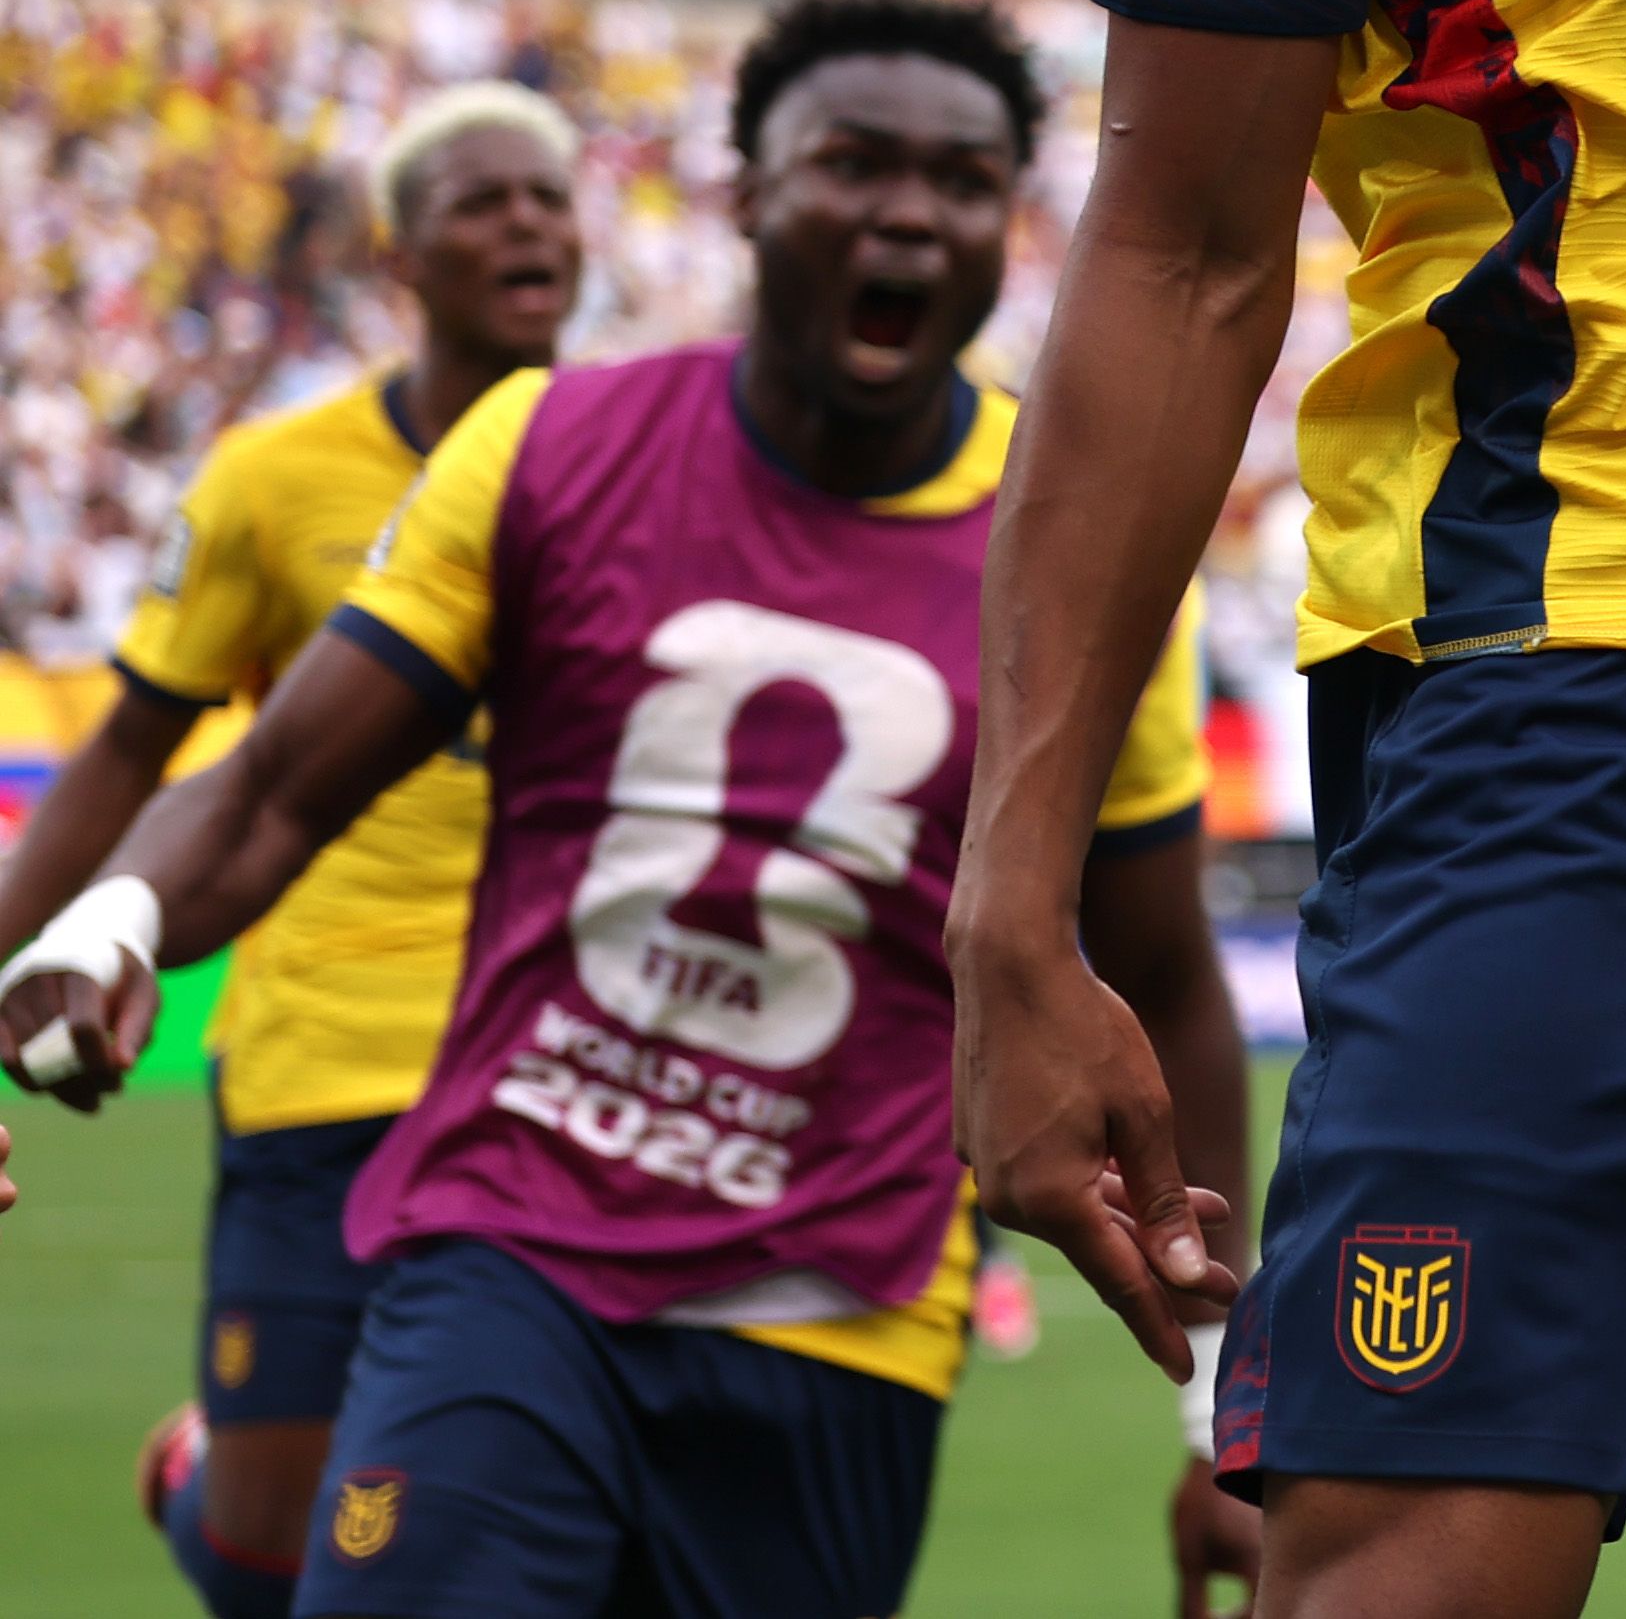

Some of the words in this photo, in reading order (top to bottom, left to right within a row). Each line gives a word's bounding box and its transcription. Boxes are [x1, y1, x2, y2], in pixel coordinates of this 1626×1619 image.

[642, 942, 762, 1015] FIFA
[491, 1049, 794, 1210] 2026
[533, 999, 702, 1106] WORLD
[704, 1072, 814, 1138] CUP
